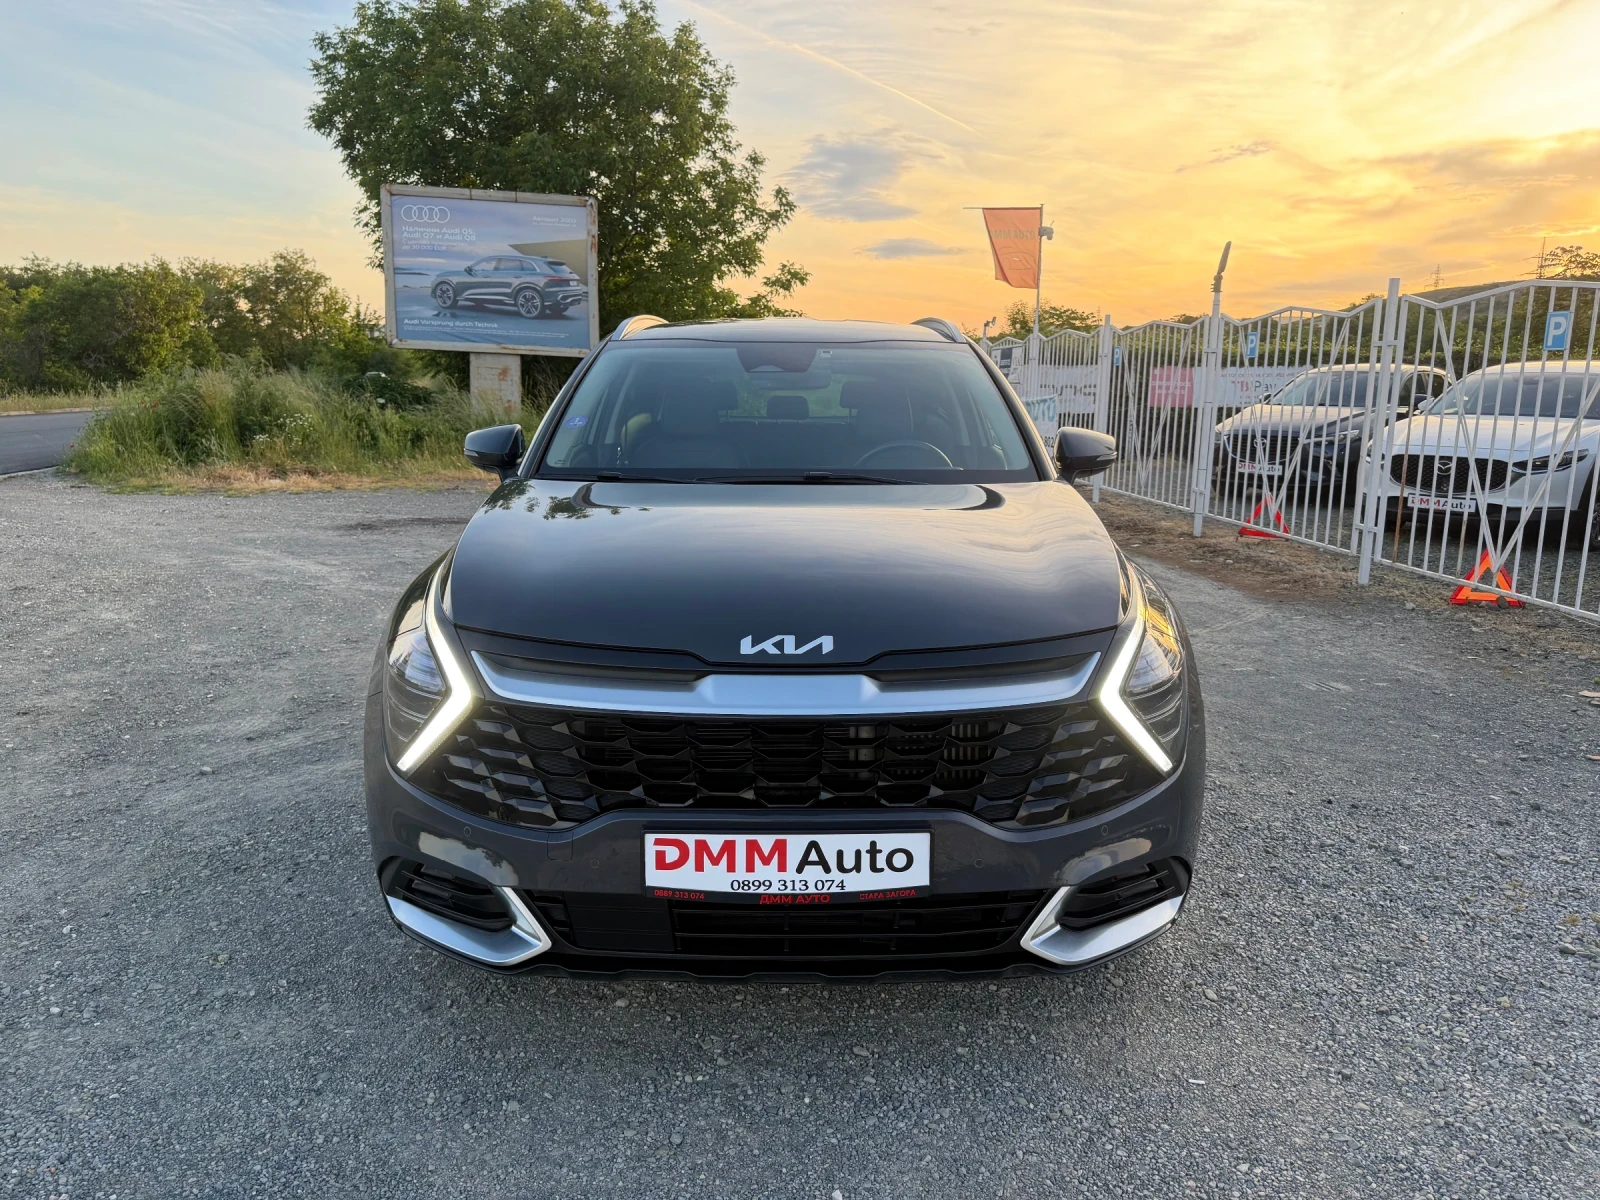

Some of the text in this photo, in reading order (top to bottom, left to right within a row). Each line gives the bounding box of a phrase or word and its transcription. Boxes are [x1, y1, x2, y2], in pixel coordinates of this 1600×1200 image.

[420, 319, 453, 327] Vorsprung
[1547, 317, 1566, 346] P
[1247, 336, 1255, 354] P
[740, 634, 834, 654] KIA
[653, 838, 914, 874] DMM Auto
[730, 879, 846, 892] 0899 313 074
[674, 891, 689, 899] 313
[690, 892, 705, 900] 074
[759, 894, 830, 905] ДММ АУТО
[859, 889, 916, 900] СТАРА ЗАГОРА
